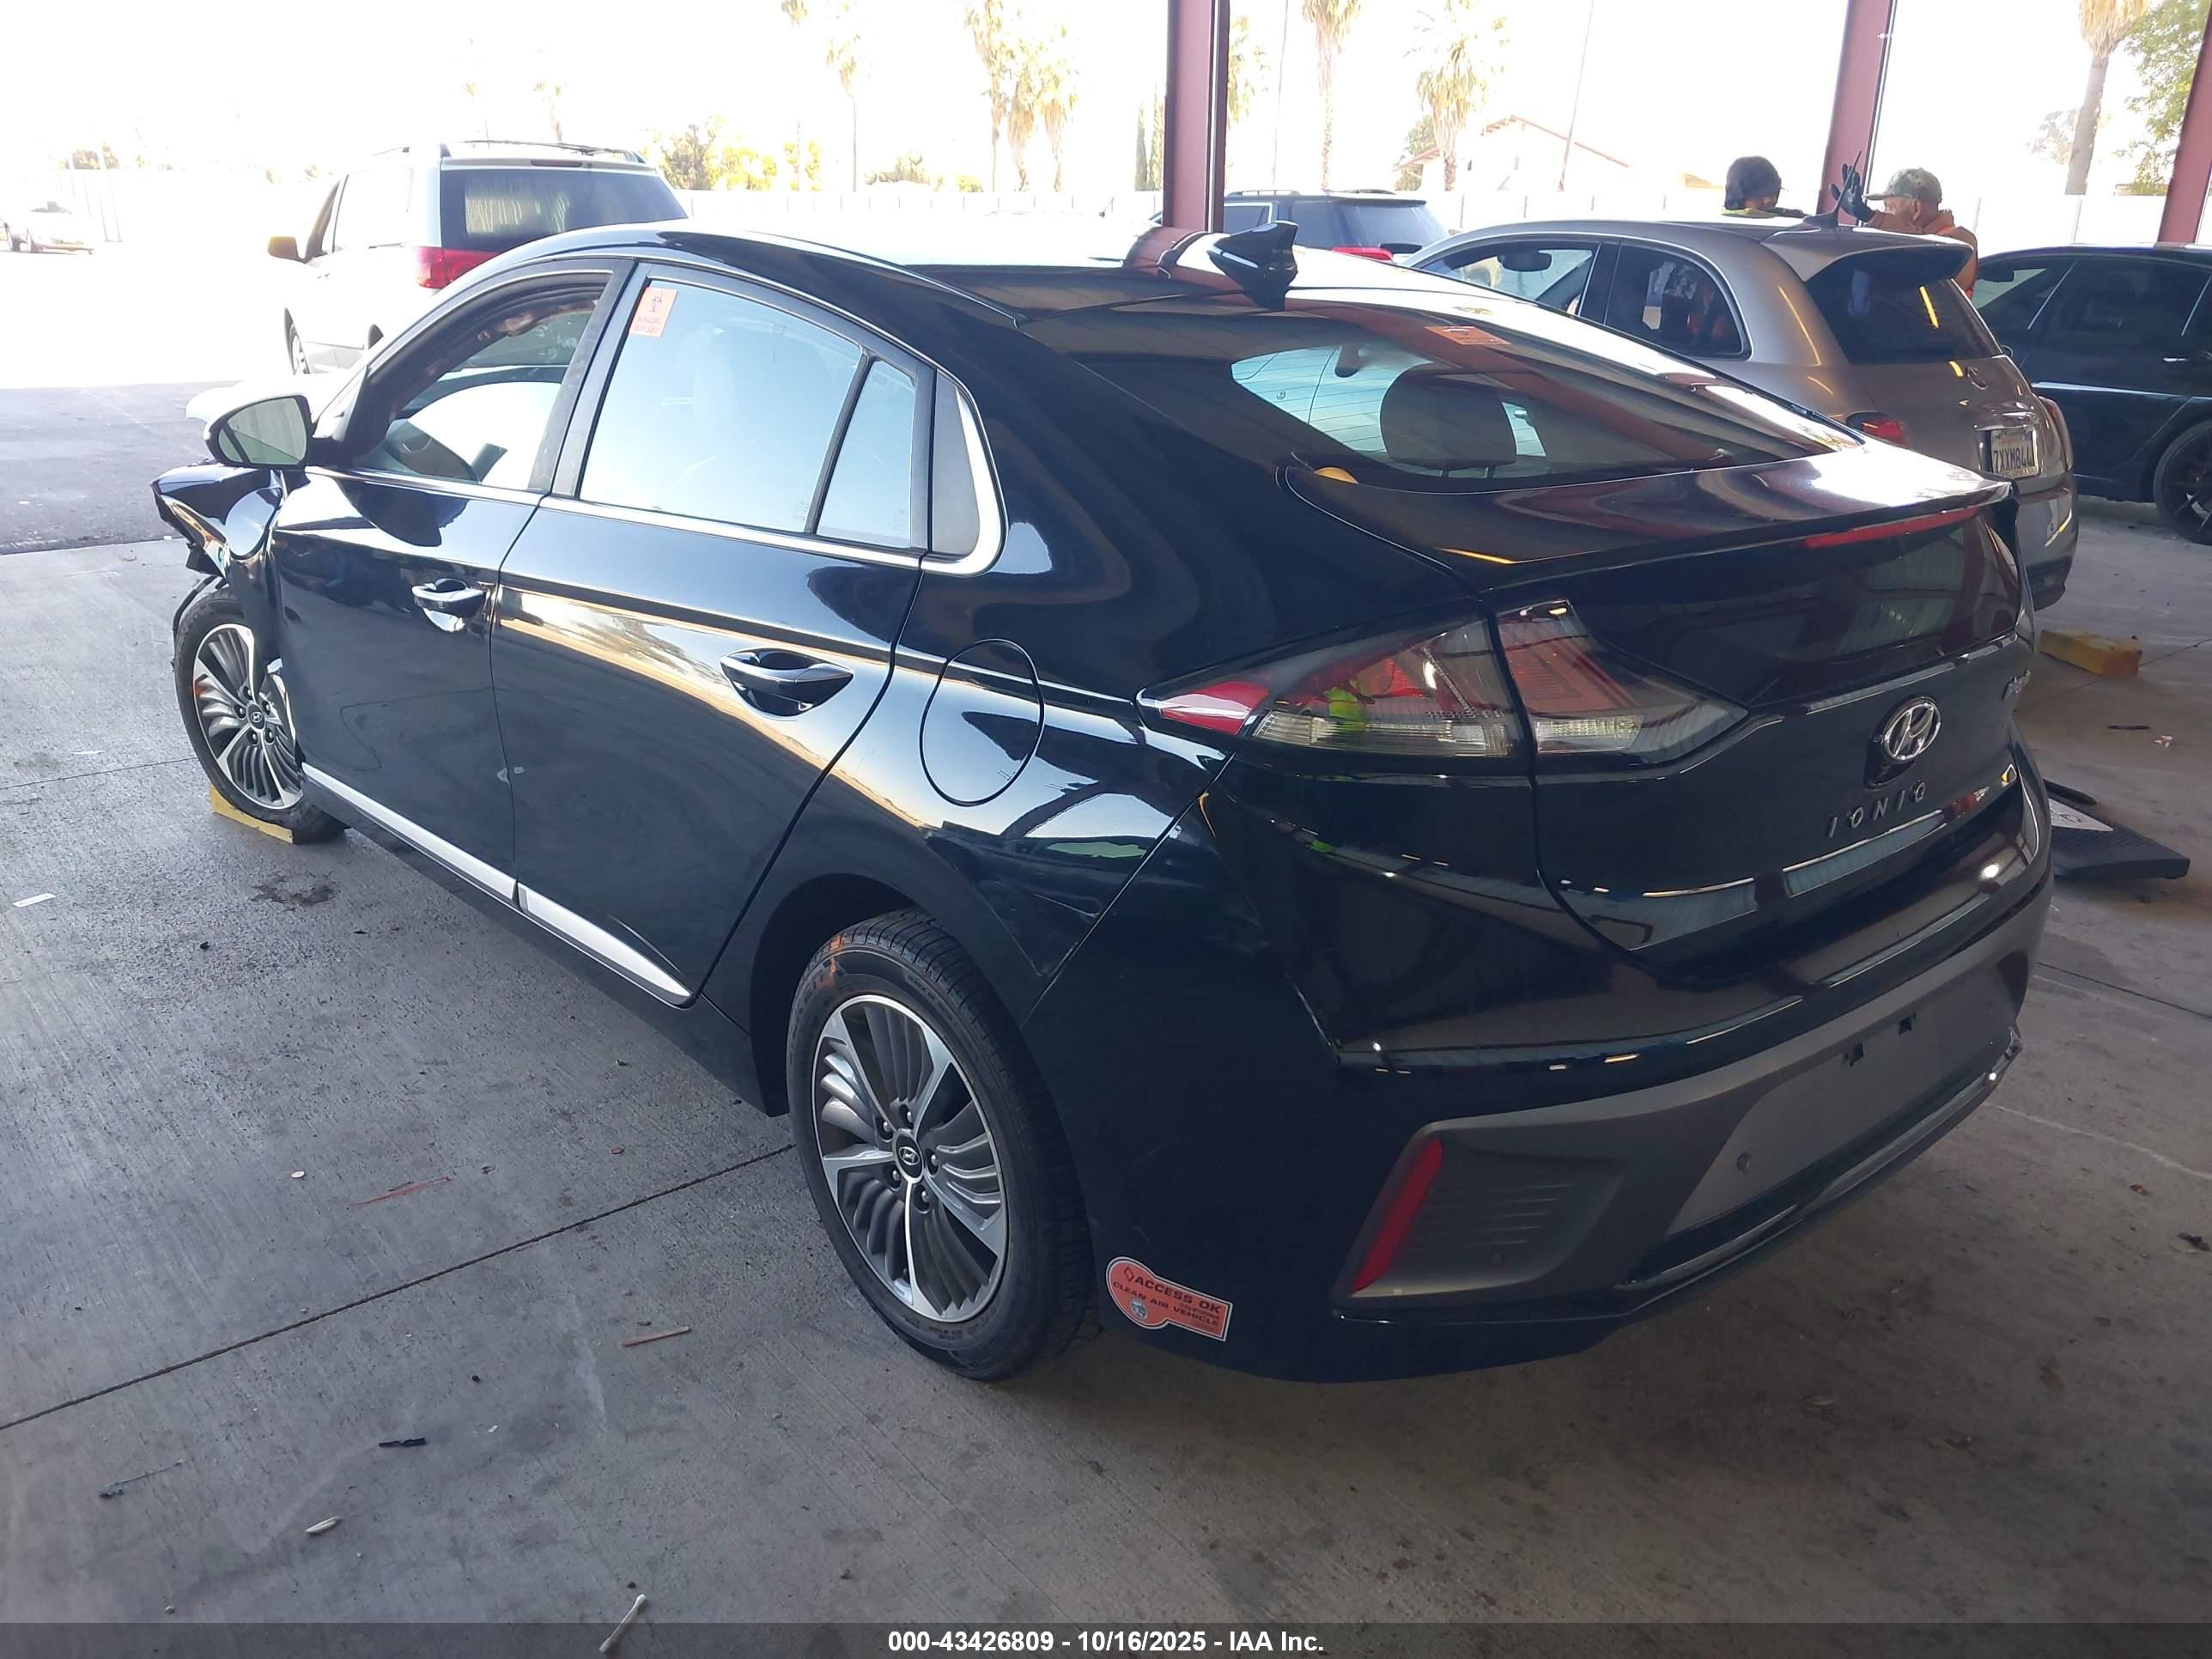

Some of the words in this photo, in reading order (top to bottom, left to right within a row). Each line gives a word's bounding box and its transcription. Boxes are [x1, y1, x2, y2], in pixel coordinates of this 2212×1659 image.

[1113, 1281, 1146, 1300] CLEAN
[1150, 1297, 1169, 1309] AIR
[1173, 1305, 1219, 1327] VEHICLE
[1134, 1276, 1193, 1304] ACCESS
[1199, 1300, 1220, 1314] OK
